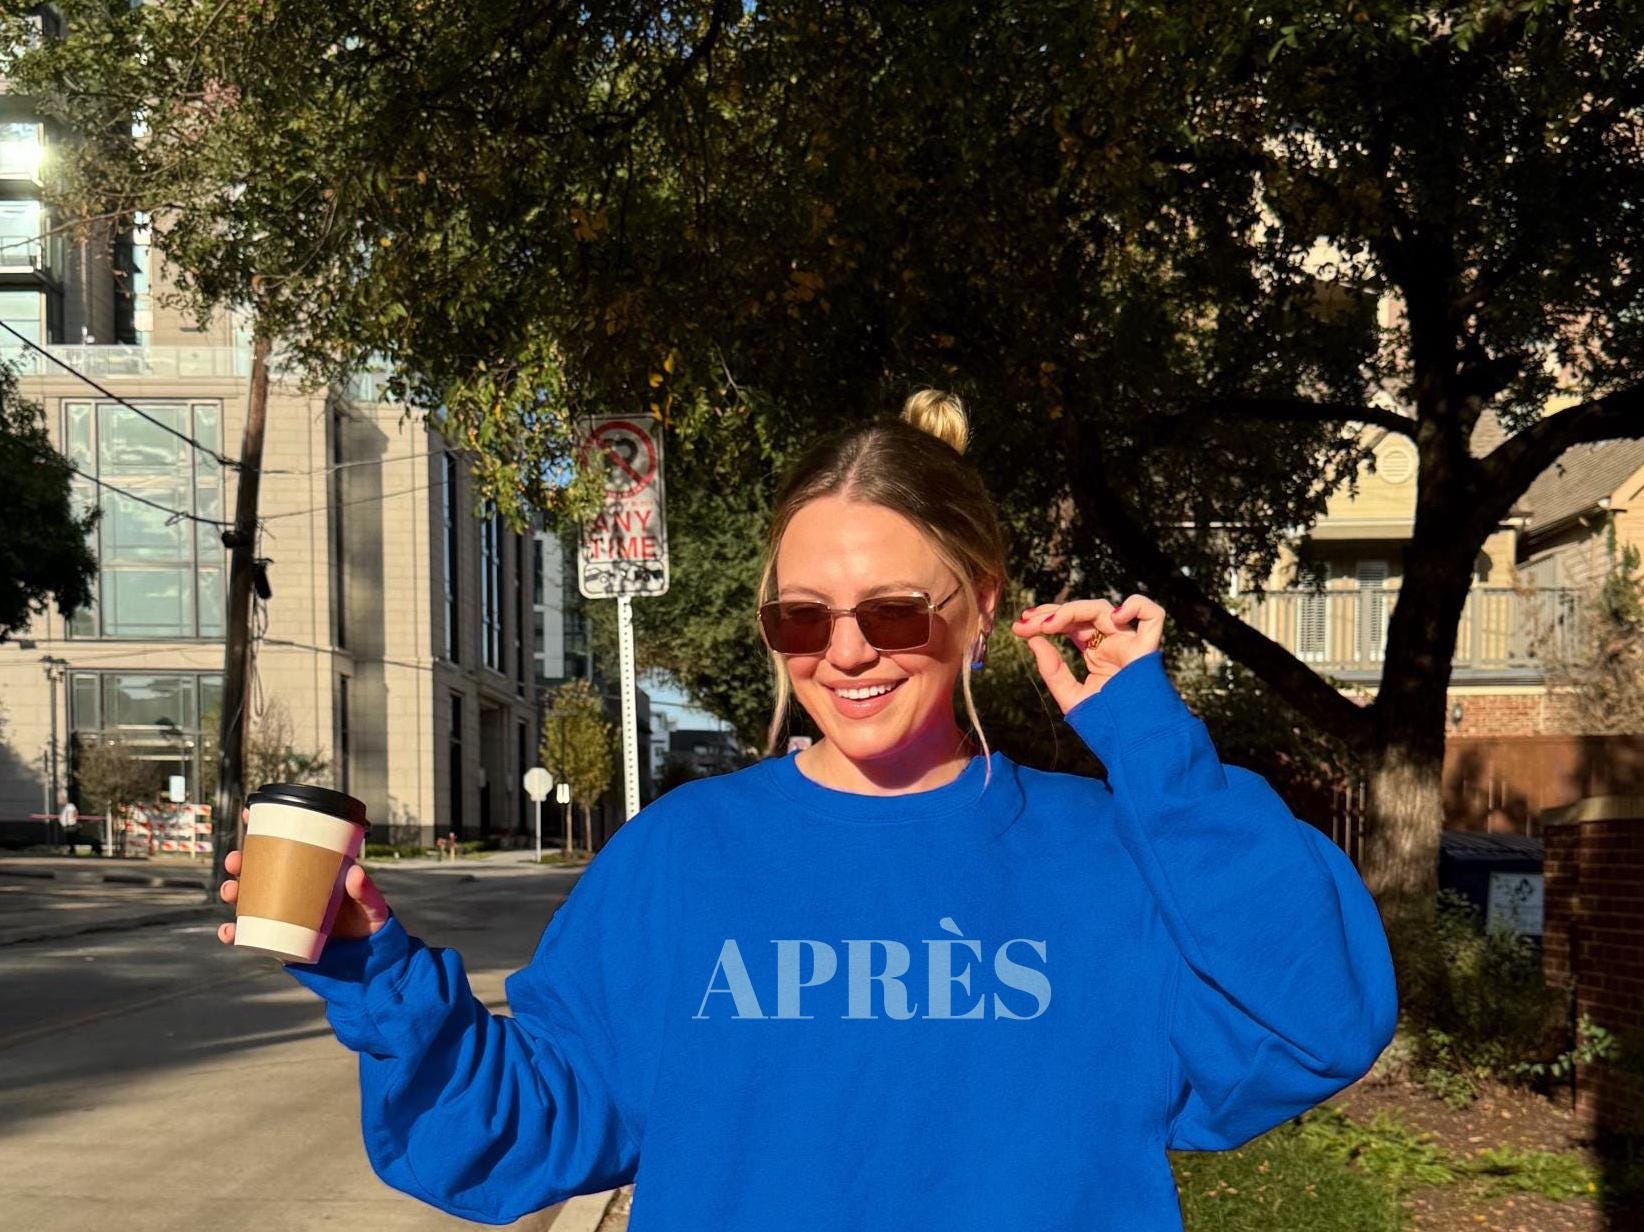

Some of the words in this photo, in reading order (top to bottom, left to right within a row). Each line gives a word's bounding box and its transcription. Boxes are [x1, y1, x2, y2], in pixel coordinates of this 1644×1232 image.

[590, 510, 652, 533] ANY
[590, 536, 657, 559] TIME
[691, 916, 1052, 1021] APRÈS
